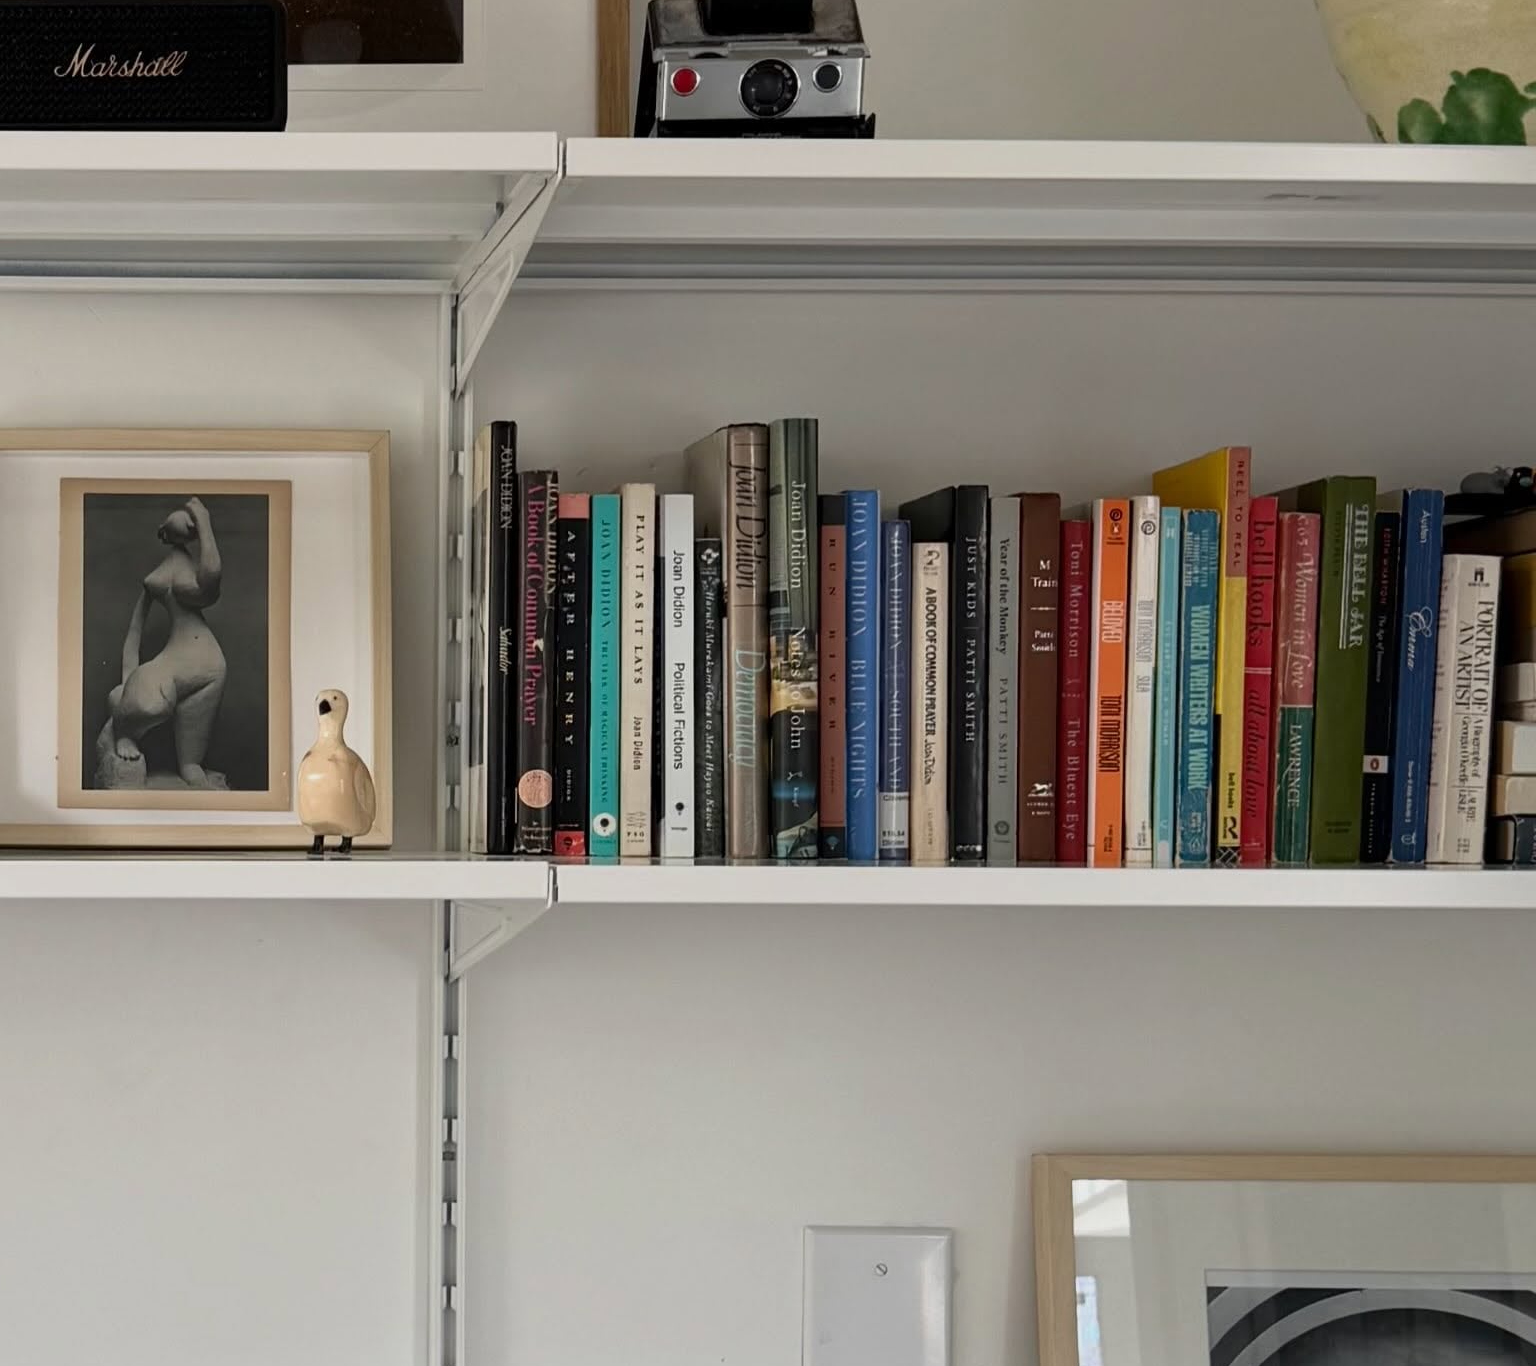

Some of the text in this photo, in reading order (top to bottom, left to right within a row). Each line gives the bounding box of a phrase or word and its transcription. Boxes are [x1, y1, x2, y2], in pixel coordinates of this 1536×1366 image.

[54, 44, 189, 79] Marshall
[633, 515, 645, 685] PLAY IT AS IT LAYS
[672, 550, 686, 627] Joan Didion
[996, 539, 1010, 654] Year of the Monkey
[1249, 520, 1274, 646] bell hooks
[1349, 504, 1368, 646] THE BELL JAR
[1102, 601, 1122, 643] BELOVED
[1191, 605, 1210, 659] WOMEN
[672, 663, 687, 769] Political Fictions
[1190, 663, 1209, 724] WRITERS
[632, 716, 643, 770] Joan Didion
[998, 678, 1008, 785] PATTI SMITH
[1189, 728, 1208, 745] AT
[1188, 748, 1208, 789] WORK
